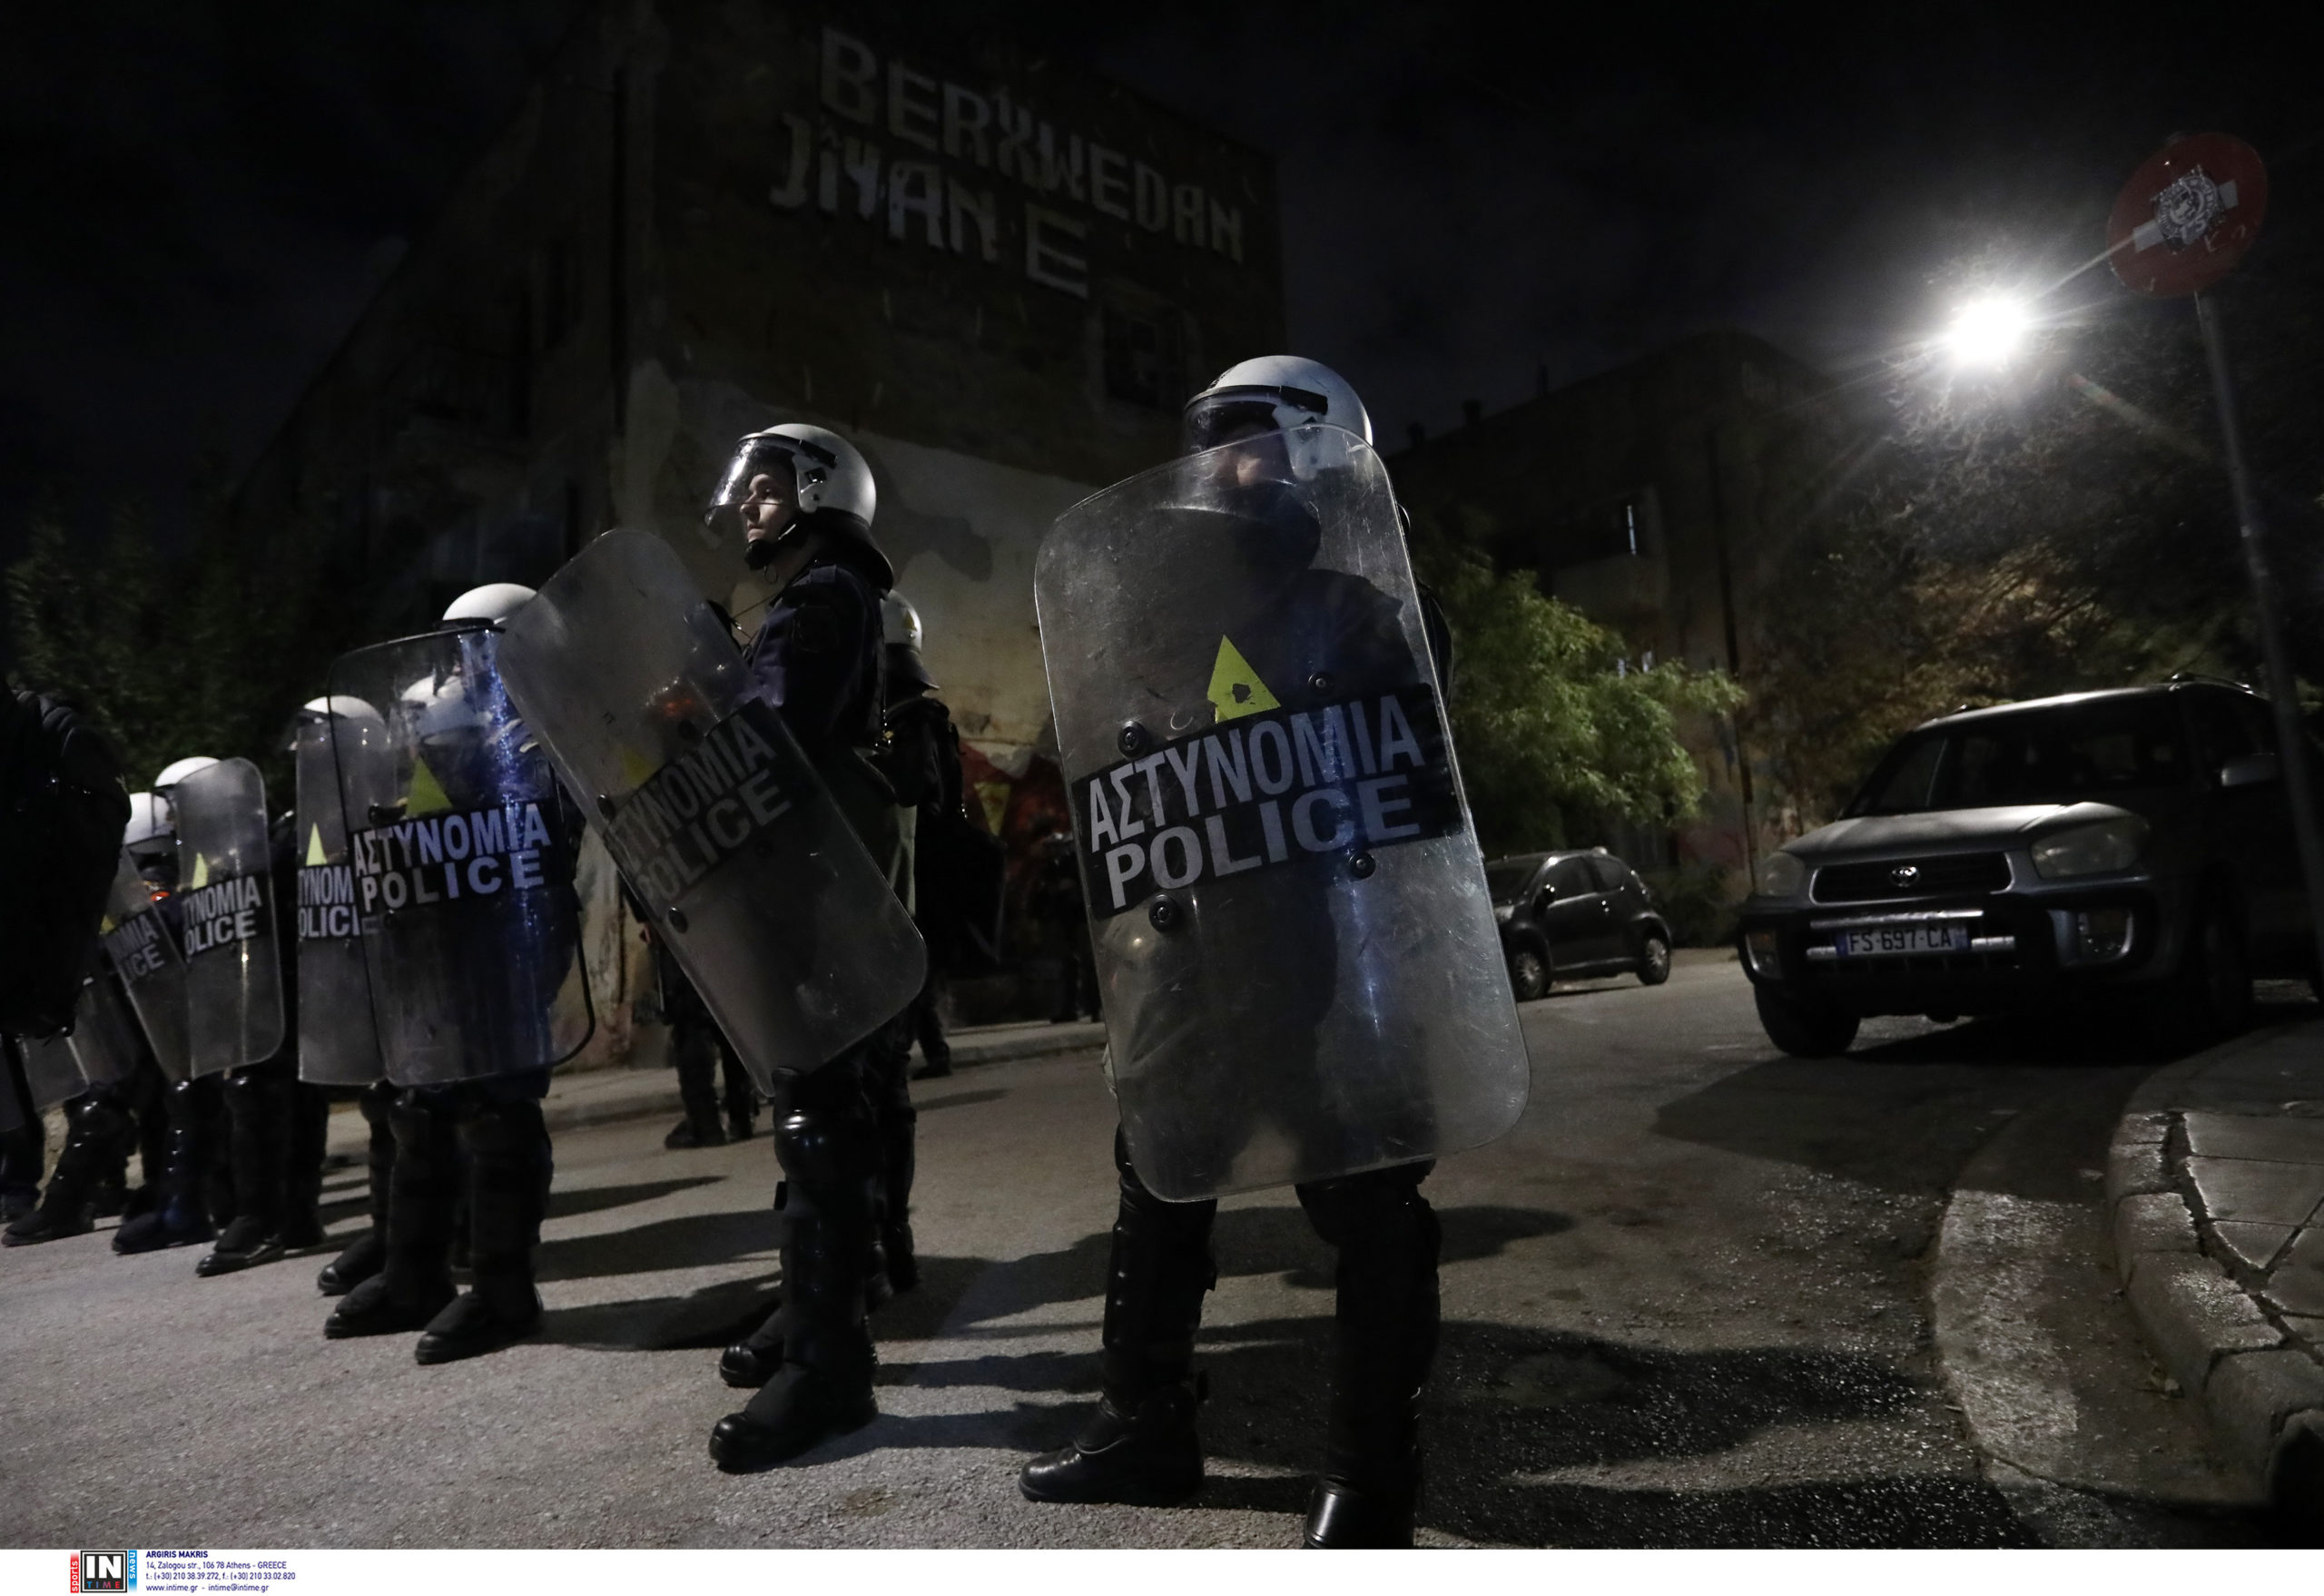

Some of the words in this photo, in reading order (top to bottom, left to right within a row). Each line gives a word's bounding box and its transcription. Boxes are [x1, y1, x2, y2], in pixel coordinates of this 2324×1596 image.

[821, 24, 1244, 266] BERXWEDAN
[1024, 201, 1089, 300] E
[1089, 695, 1426, 853] ΑΣΤΥΝΟΜΙΑ
[353, 802, 552, 878] ΑΣΤΥΝΟΜΙΑ
[361, 848, 545, 912] POLICE
[1104, 773, 1422, 910] POLICE
